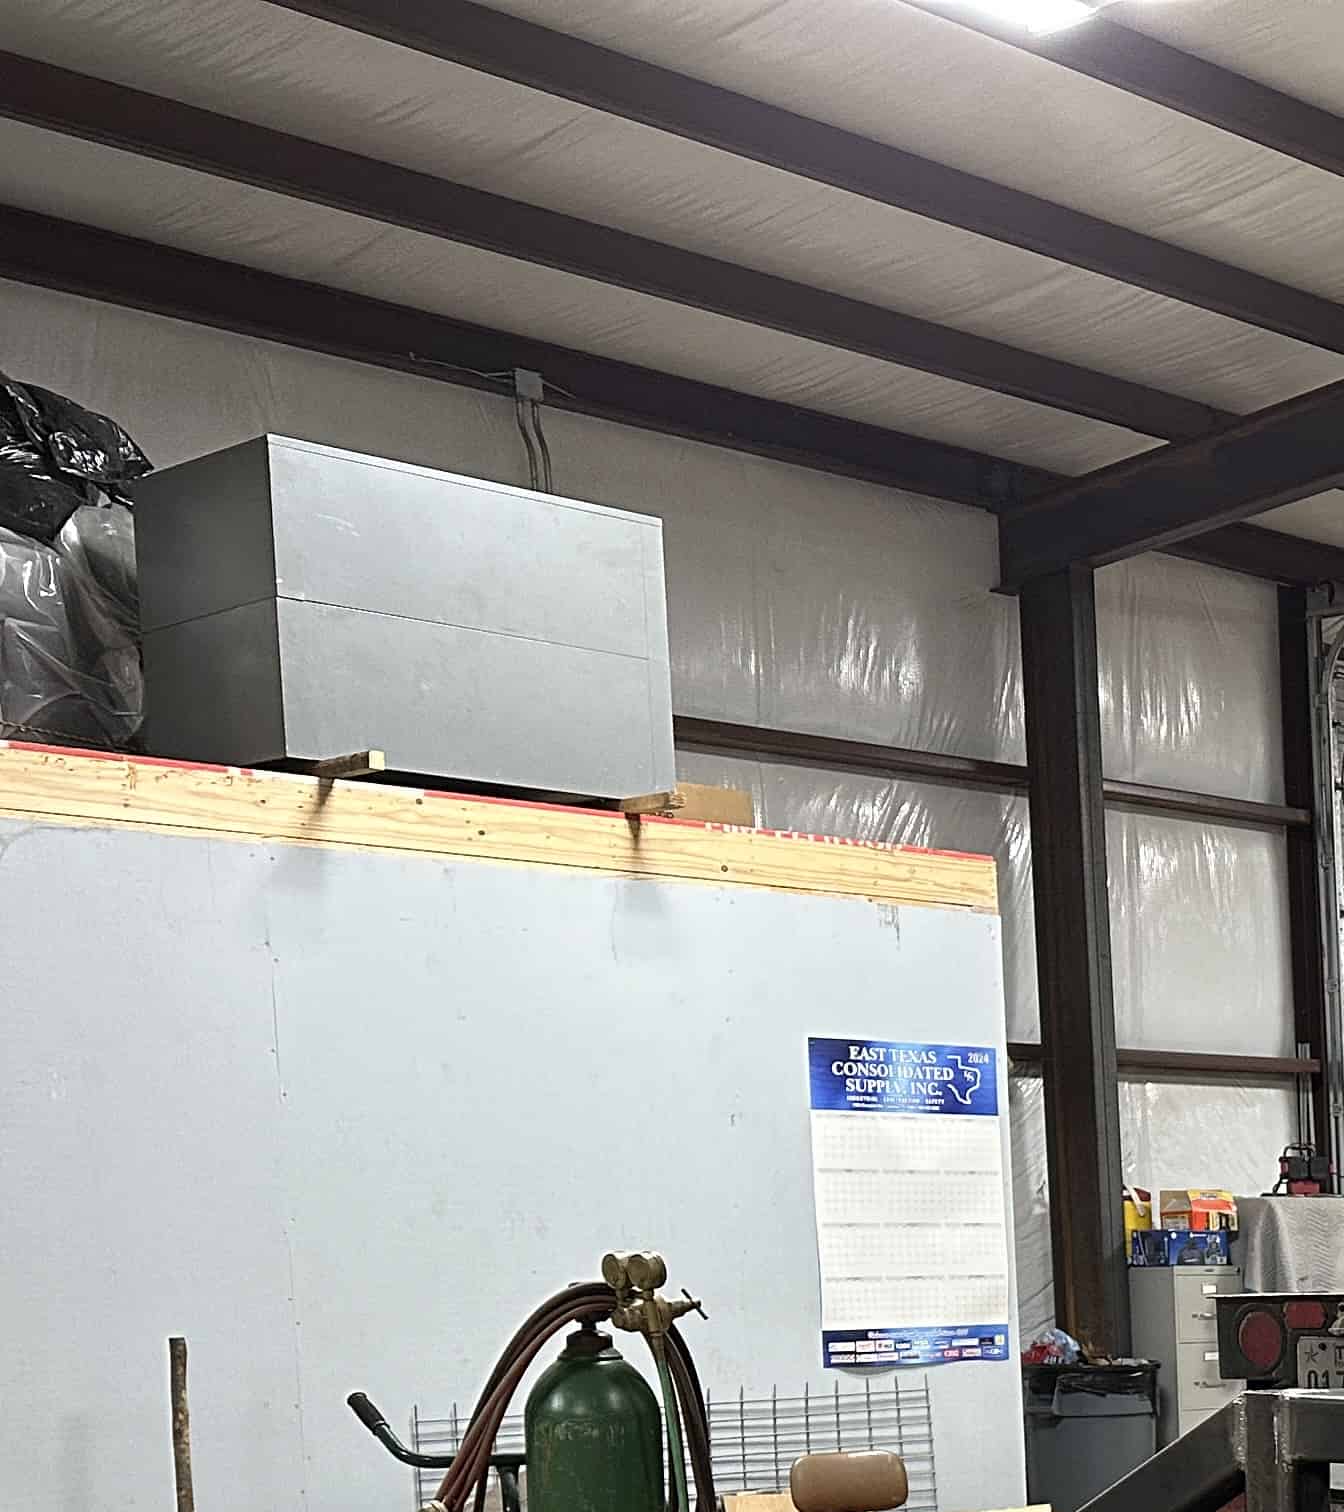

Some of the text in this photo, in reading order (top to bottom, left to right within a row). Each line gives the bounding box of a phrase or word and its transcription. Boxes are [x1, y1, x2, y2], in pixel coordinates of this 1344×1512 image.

[848, 1045, 937, 1064] EAST TEXAS
[831, 1060, 955, 1081] CONSOLIDATED
[911, 1081, 943, 1096] INC.
